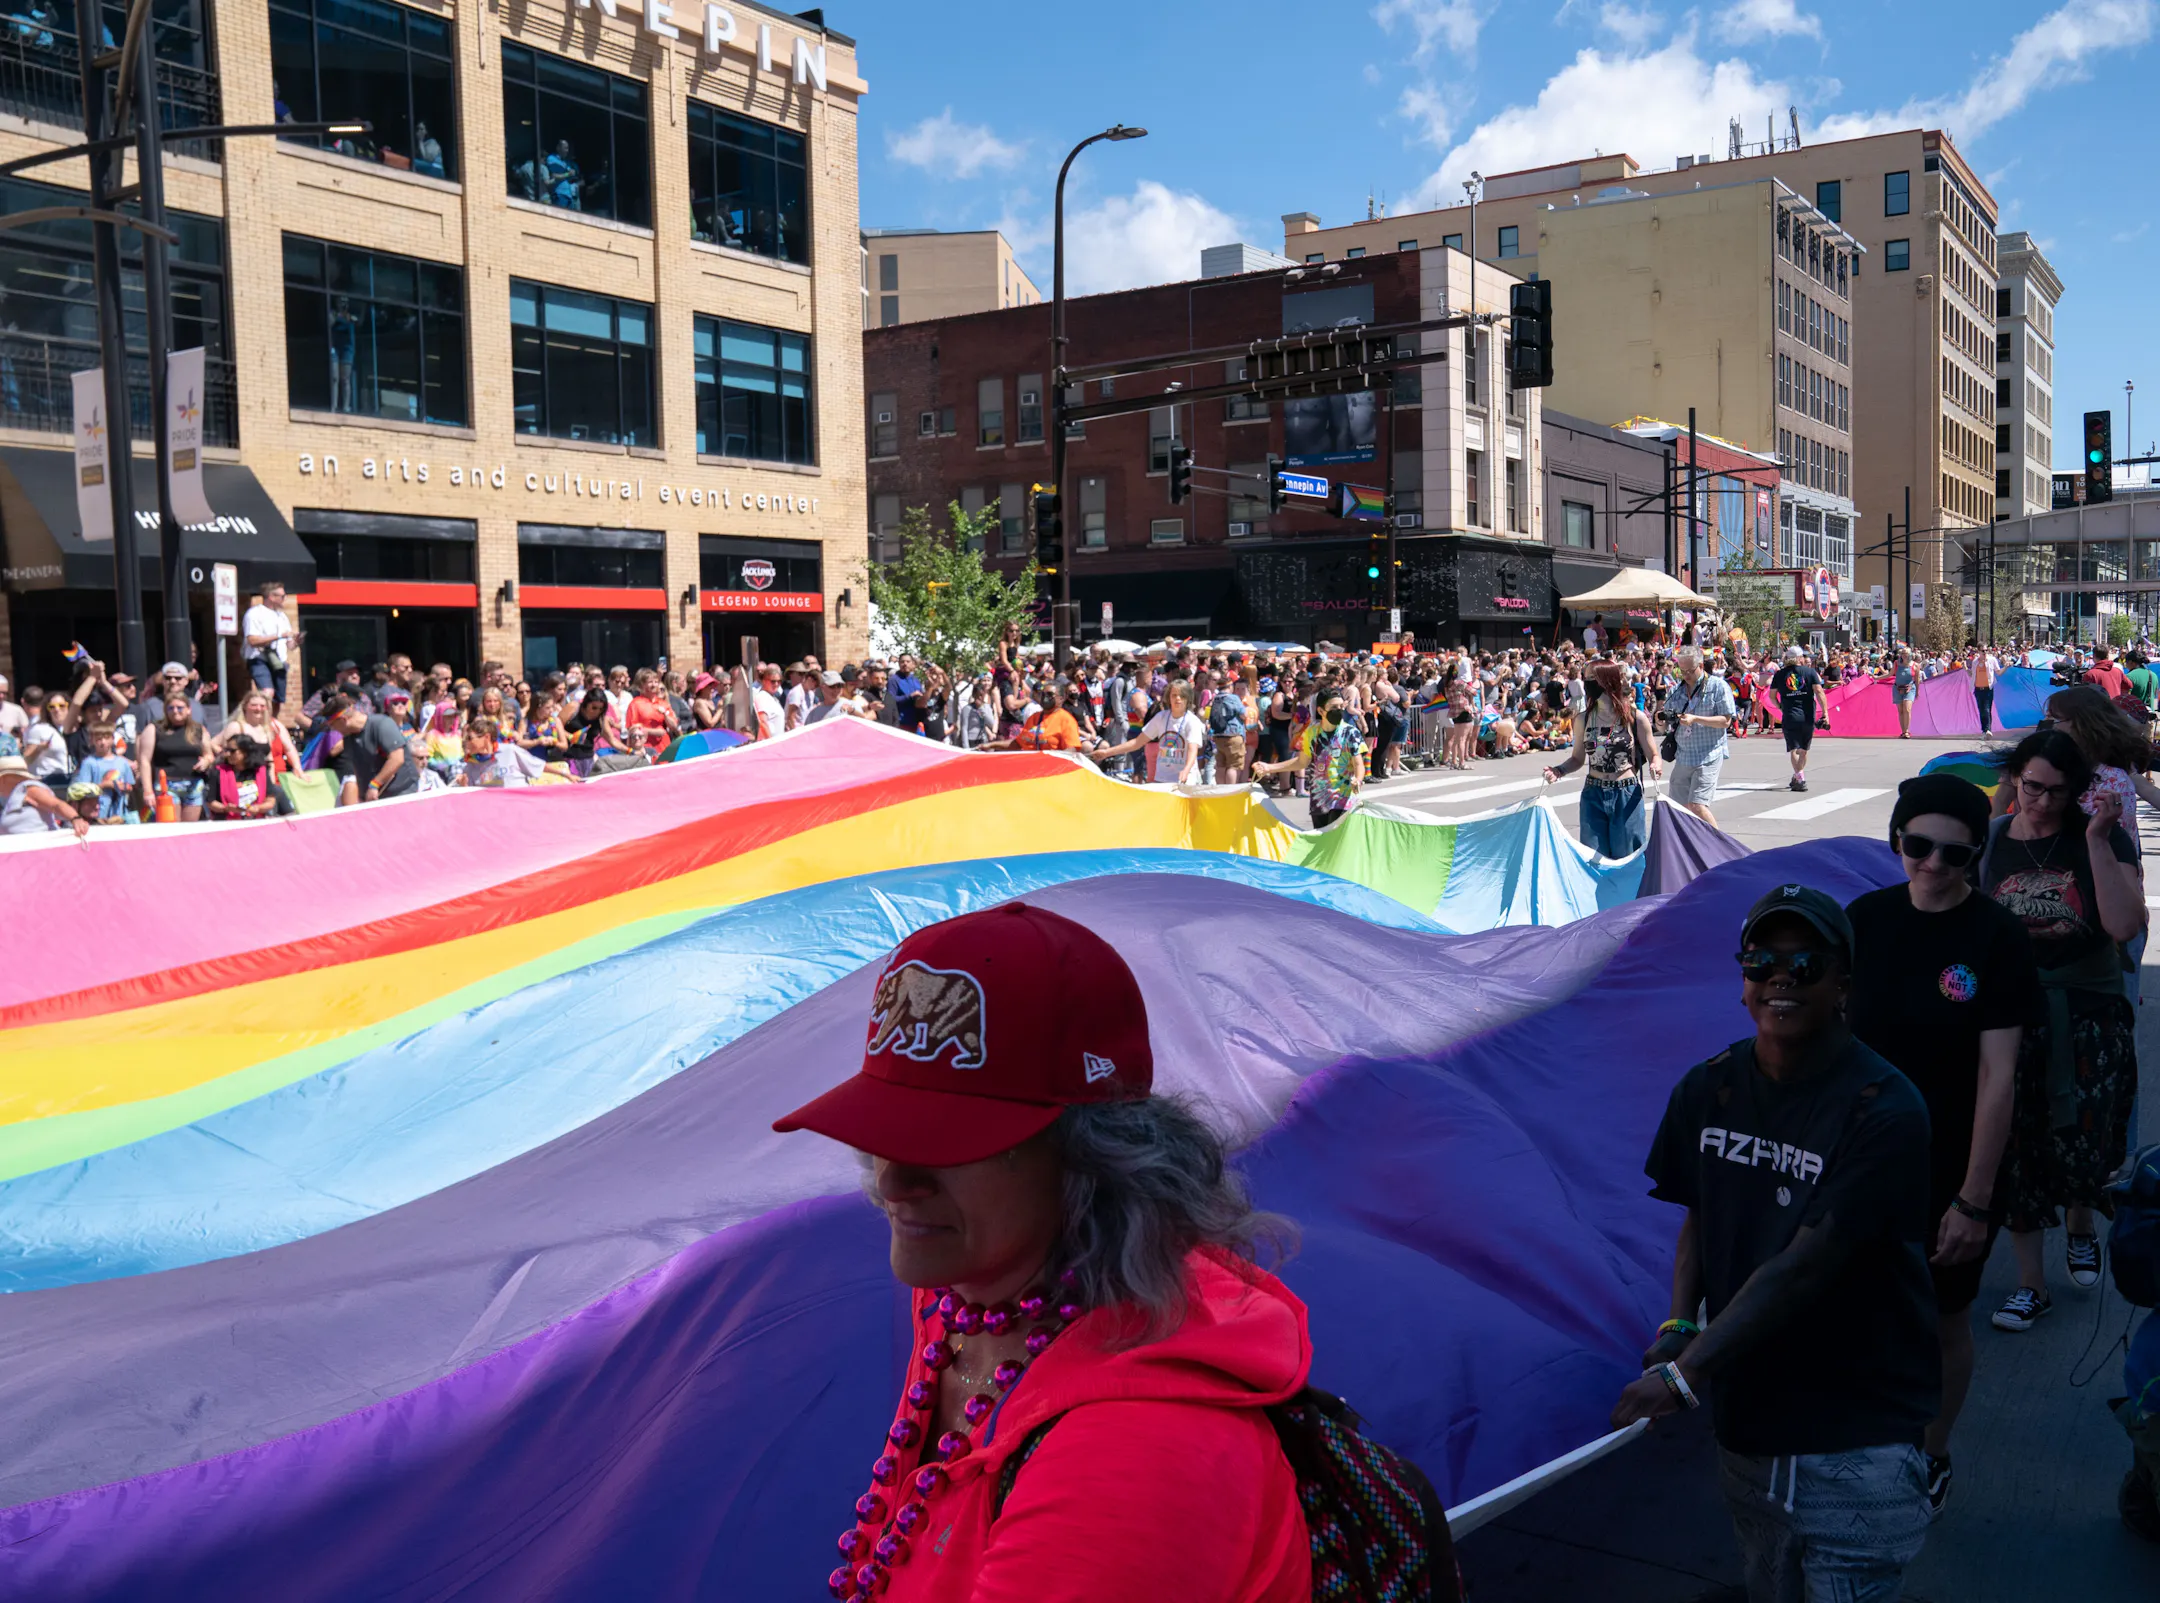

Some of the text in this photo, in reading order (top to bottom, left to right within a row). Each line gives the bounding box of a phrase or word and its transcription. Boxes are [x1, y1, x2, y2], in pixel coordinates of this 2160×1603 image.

[172, 427, 197, 442] PRIDE
[299, 452, 820, 514] an arts and cultural event center
[1279, 477, 1326, 493] ennepin Av
[711, 595, 810, 608] LEGEND LOUNGE
[1500, 597, 1529, 608] SALOON
[1952, 973, 1967, 983] I'M
[1948, 981, 1968, 992] NOT
